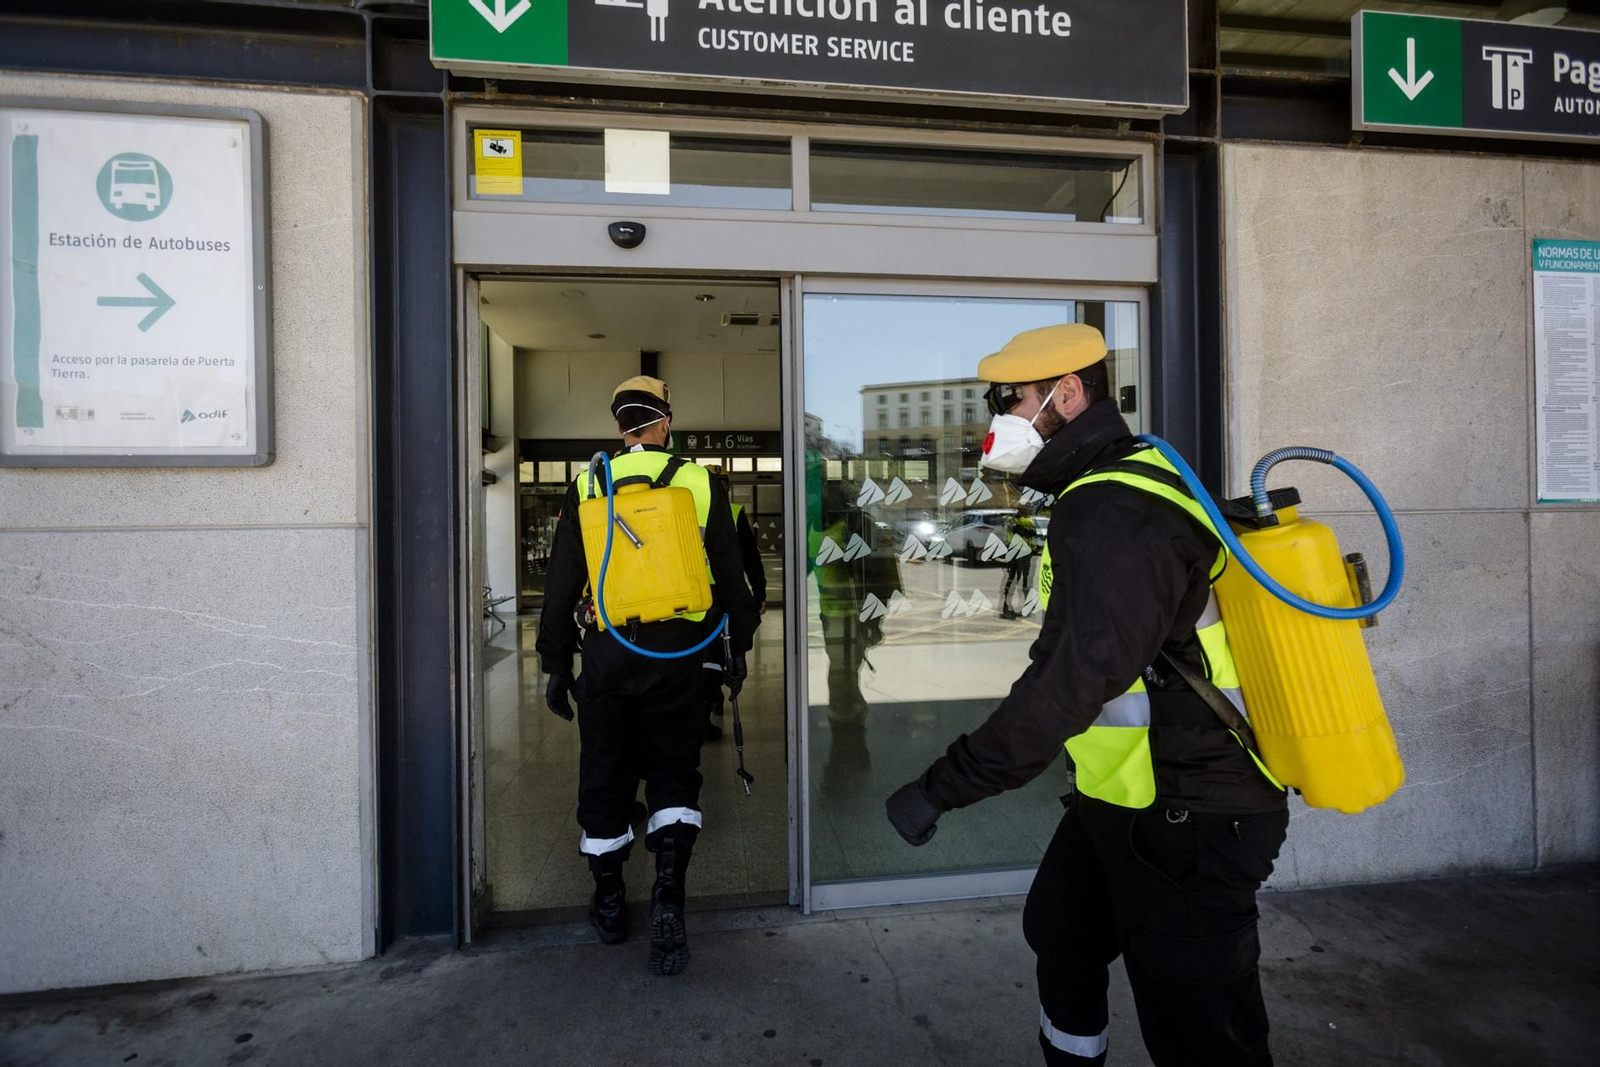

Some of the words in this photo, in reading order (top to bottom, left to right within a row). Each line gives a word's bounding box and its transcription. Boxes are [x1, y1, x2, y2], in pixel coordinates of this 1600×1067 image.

[895, 0, 928, 26] al
[944, 0, 1072, 37] cliente
[697, 27, 819, 56] CUSTOMER
[827, 36, 915, 62] SERVICE
[49, 232, 116, 248] Estación
[122, 235, 142, 249] de
[149, 236, 231, 252] Autobuses
[1538, 246, 1579, 259] NORMAS
[1580, 248, 1593, 260] DE
[52, 353, 92, 365] Acceso
[95, 356, 114, 366] por
[117, 355, 127, 365] la
[131, 355, 179, 366] pasarela
[182, 356, 196, 366] de
[198, 356, 235, 367] Puerta
[50, 368, 90, 380] Tierra.
[703, 434, 713, 449] 1
[715, 441, 722, 449] a
[725, 434, 735, 449] 6
